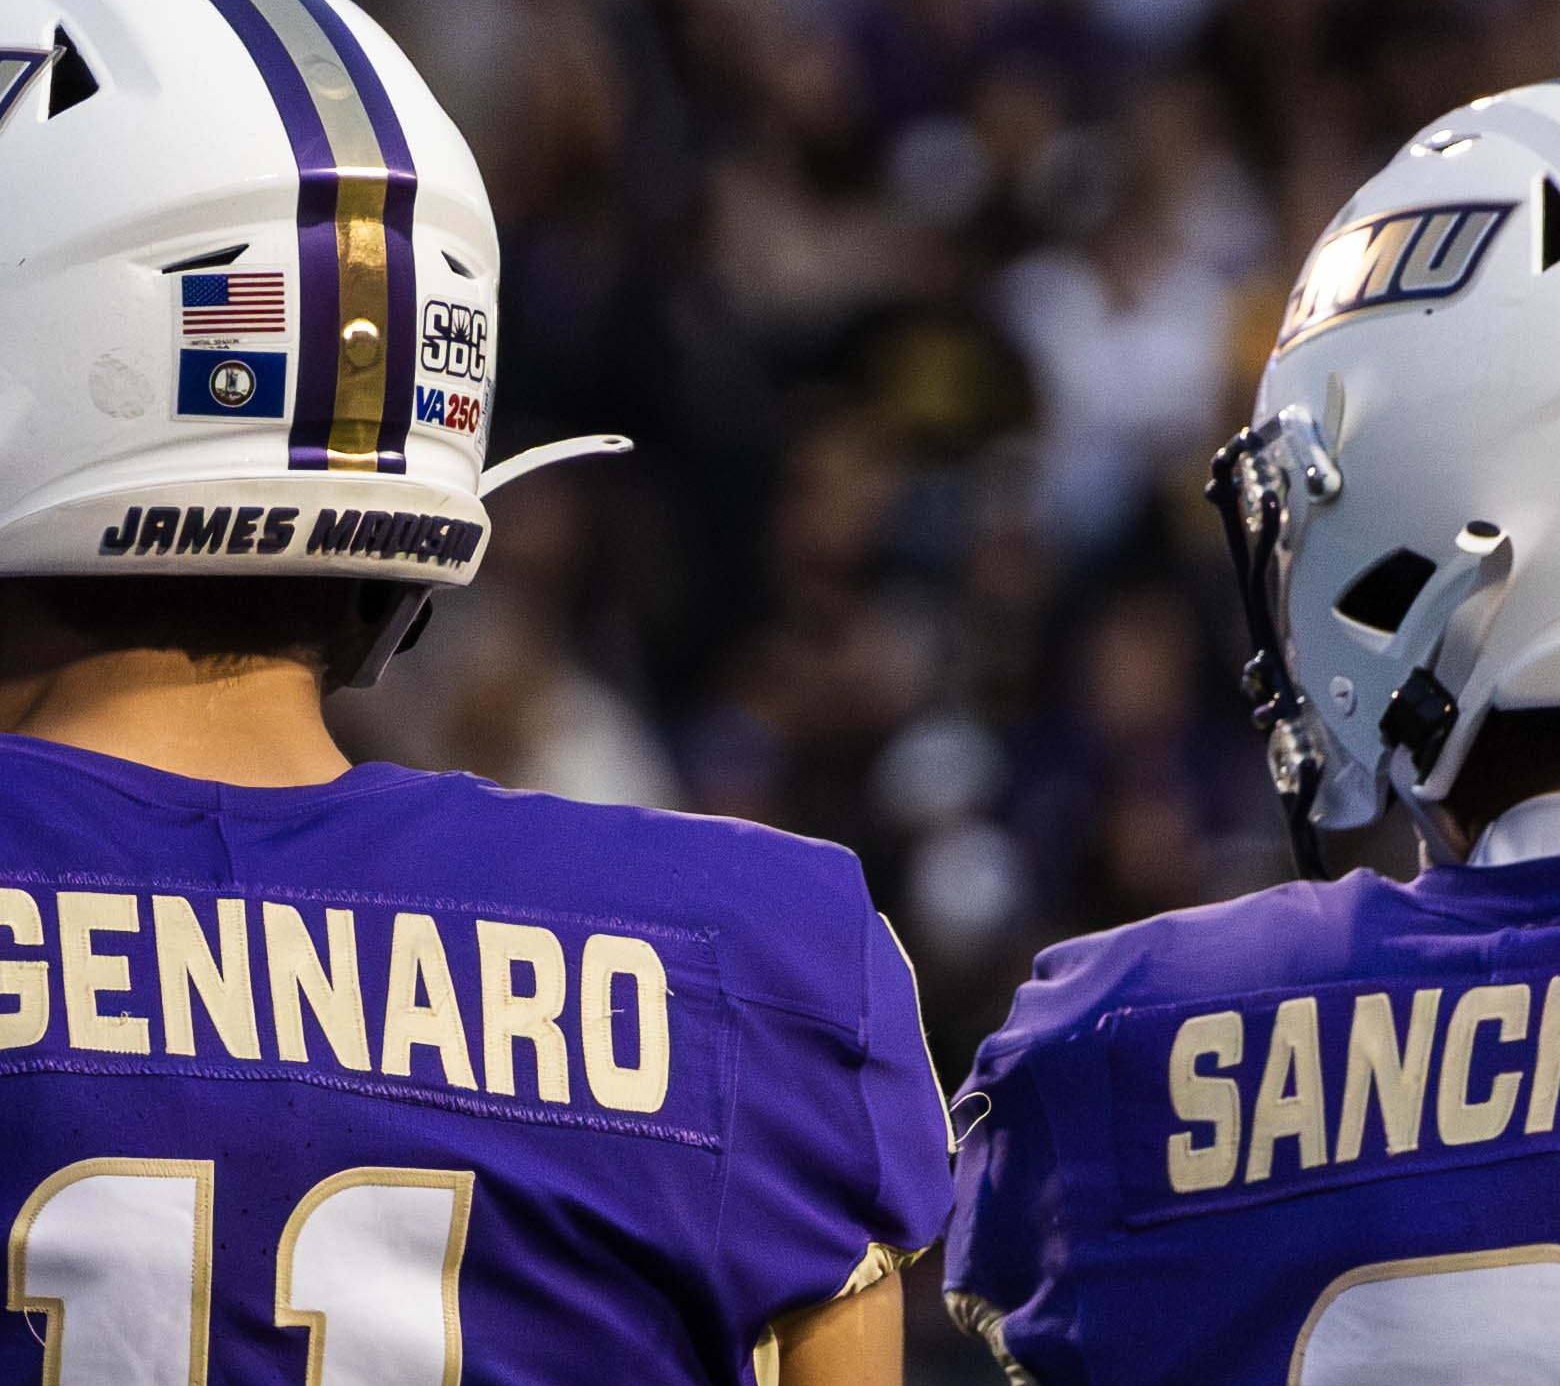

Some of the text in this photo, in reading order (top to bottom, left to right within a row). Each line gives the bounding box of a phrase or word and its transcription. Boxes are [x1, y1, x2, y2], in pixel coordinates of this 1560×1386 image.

[421, 300, 487, 381] SBC
[416, 385, 480, 434] VA250
[99, 506, 299, 556] JAMES
